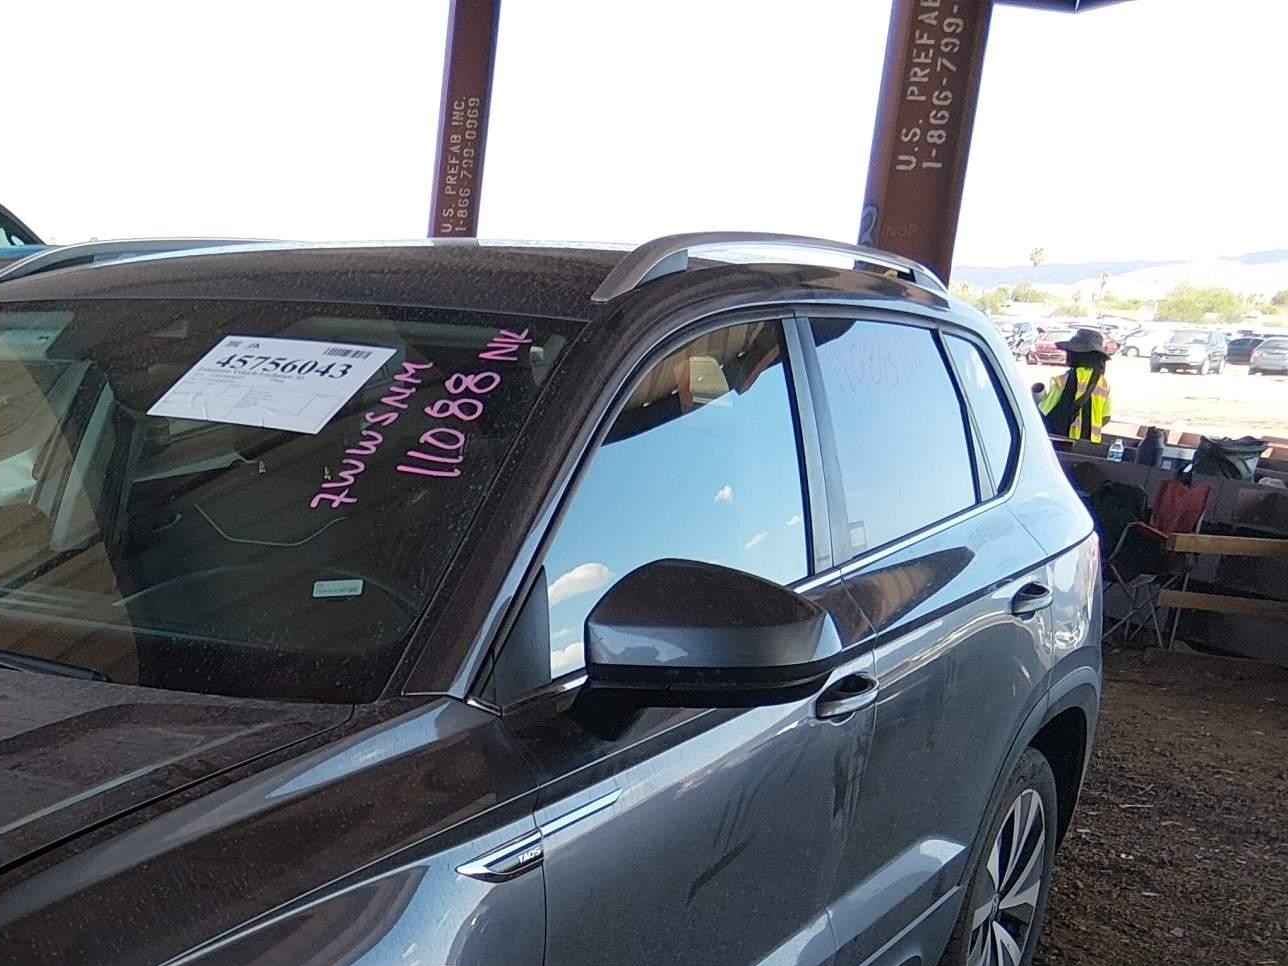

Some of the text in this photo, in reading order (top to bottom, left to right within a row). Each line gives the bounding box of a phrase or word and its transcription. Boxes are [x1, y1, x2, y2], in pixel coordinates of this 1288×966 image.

[440, 96, 466, 233] U.S. PREFAB INC.
[454, 97, 481, 232] 1-866-799-0969
[896, 119, 923, 171] U.S.
[215, 353, 353, 379] 45756043
[395, 371, 501, 478] 11088
[518, 846, 542, 864] TAOS
